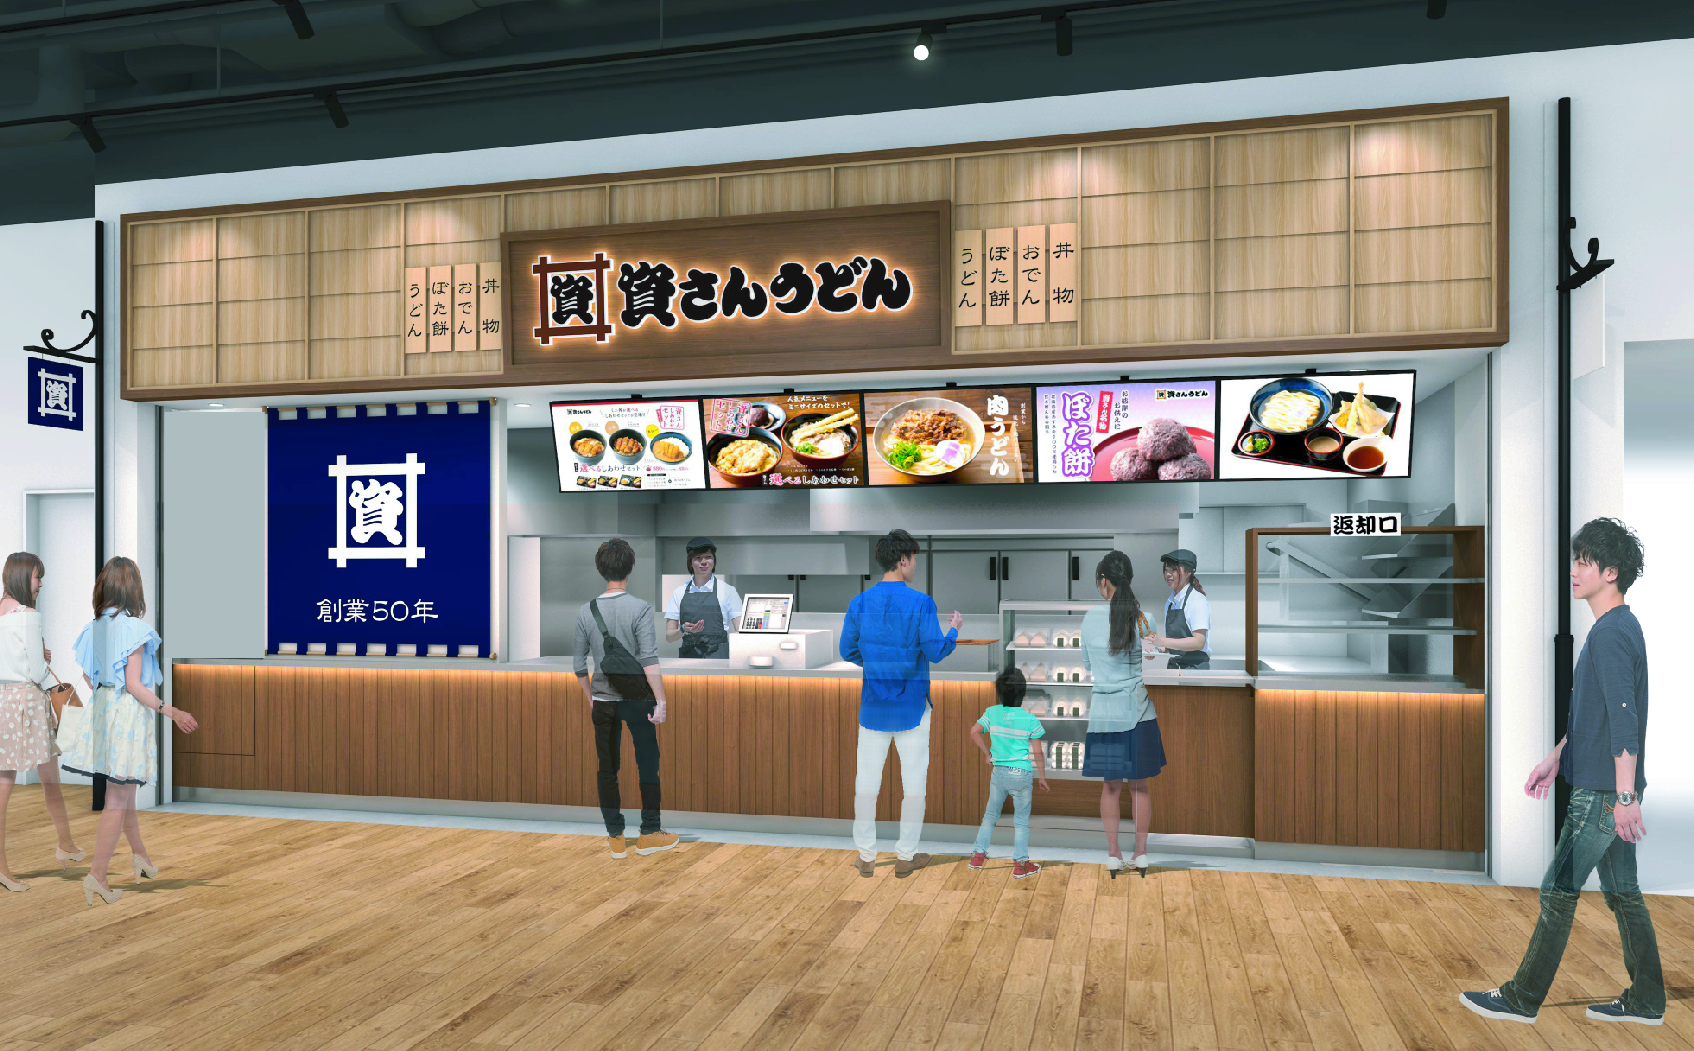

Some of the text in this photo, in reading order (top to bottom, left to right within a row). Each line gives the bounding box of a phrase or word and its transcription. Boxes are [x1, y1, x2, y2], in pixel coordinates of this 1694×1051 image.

[617, 255, 913, 328] 資さんうどん
[958, 248, 978, 308] うどん
[988, 246, 1010, 307] ぼた餅
[1022, 244, 1041, 306] おでん
[407, 283, 424, 338] うどん
[431, 281, 450, 336] ぼた餅
[457, 280, 473, 334] おでん
[987, 394, 1010, 476] 肉うどん
[1062, 392, 1093, 477] ぼた餅
[1333, 515, 1398, 535] 返却口
[316, 598, 439, 624] 創業50年
